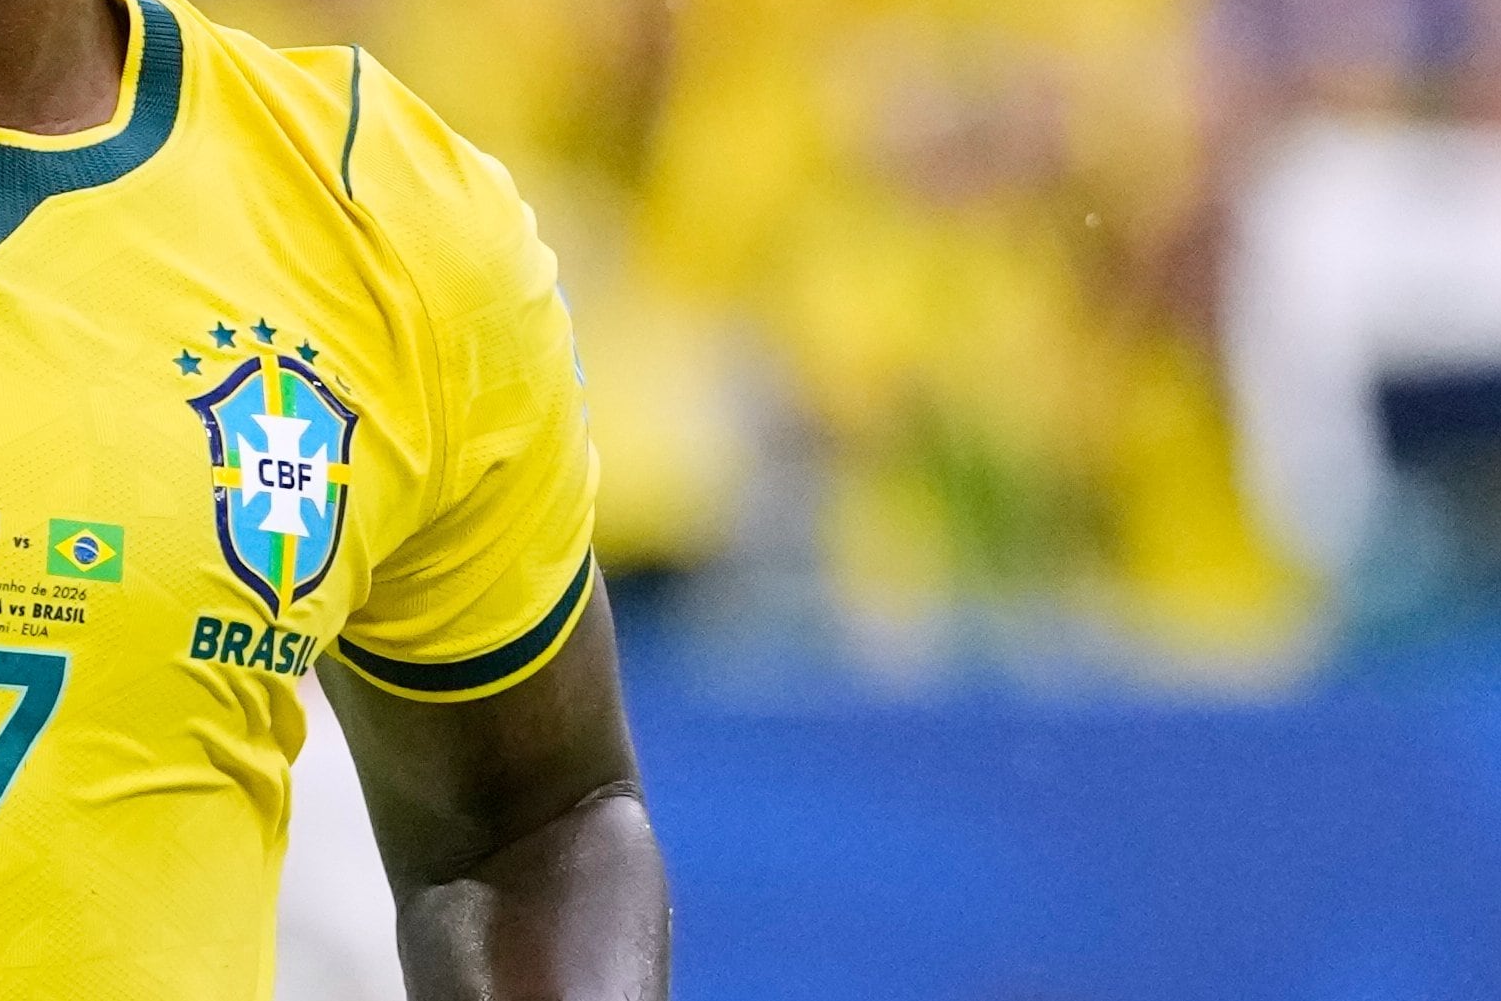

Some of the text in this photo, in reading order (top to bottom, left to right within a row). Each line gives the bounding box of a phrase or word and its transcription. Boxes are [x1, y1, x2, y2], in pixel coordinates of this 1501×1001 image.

[258, 457, 313, 491] CBF
[12, 535, 31, 549] vs
[31, 582, 47, 597] de
[53, 584, 88, 601] 2026
[9, 604, 26, 617] vs
[32, 603, 86, 624] BRASIL
[21, 623, 49, 638] EUA
[190, 615, 318, 677] BRASIL
